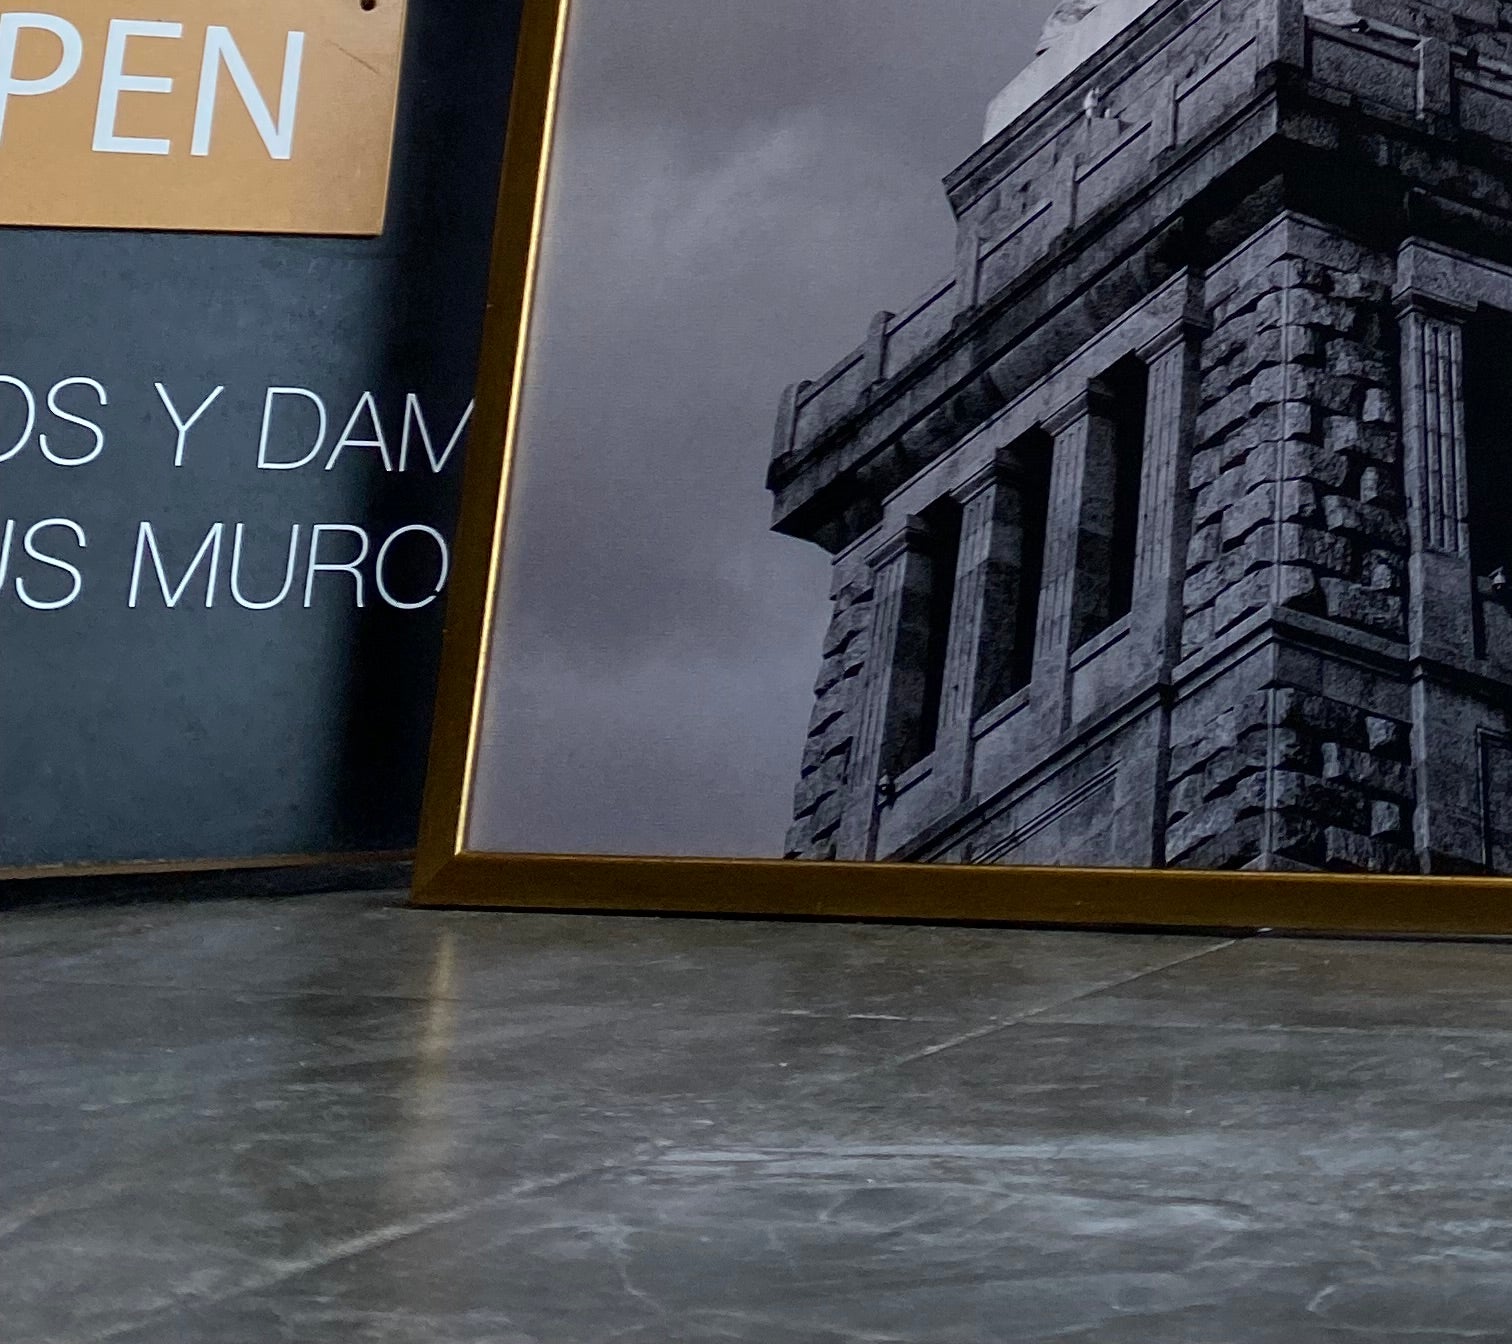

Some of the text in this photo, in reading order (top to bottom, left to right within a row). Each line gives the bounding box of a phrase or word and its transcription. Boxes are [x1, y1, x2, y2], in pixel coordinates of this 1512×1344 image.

[0, 12, 306, 160] PEN
[154, 382, 225, 467] Y
[128, 521, 449, 610] MURO
